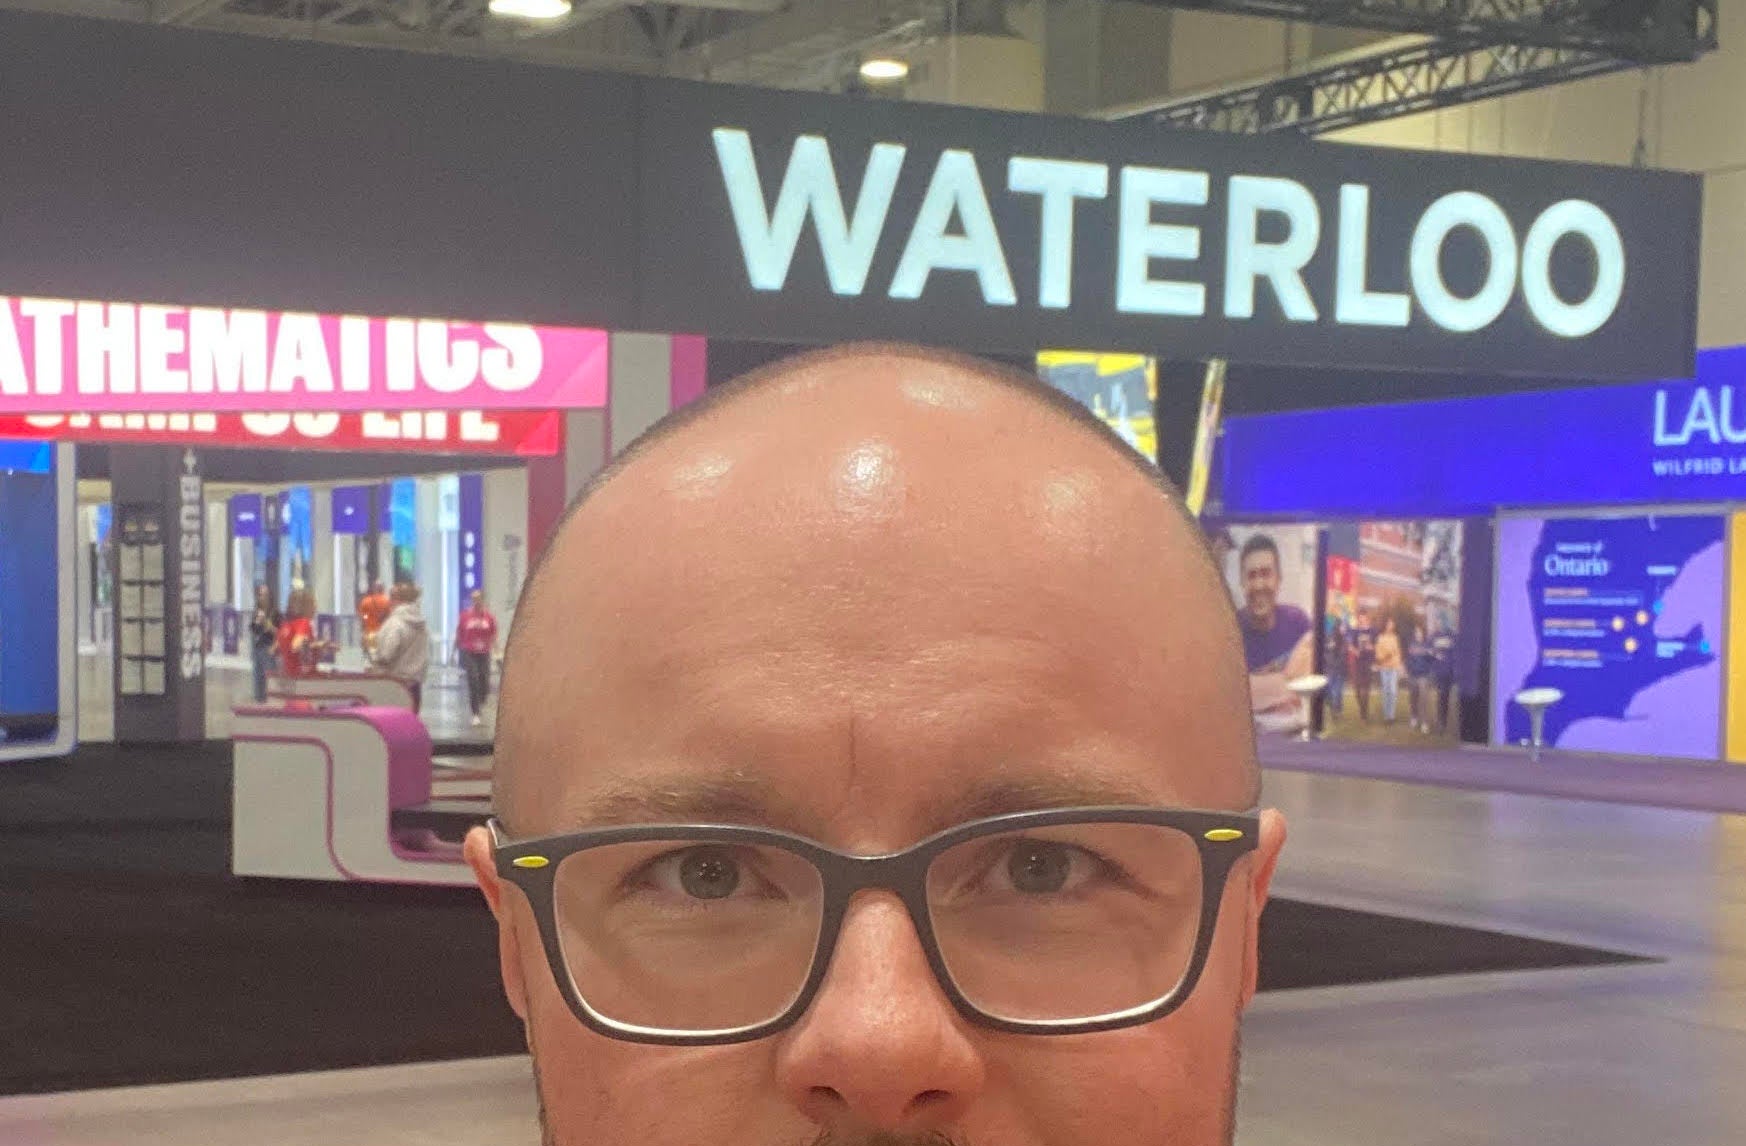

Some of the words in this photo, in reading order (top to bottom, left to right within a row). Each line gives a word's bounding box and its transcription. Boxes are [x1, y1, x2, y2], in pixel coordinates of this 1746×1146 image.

[712, 127, 1625, 337] WATERLOO
[1653, 457, 1723, 476] WILFRID
[180, 475, 202, 680] BUSINESS
[1544, 553, 1609, 577] Ontario
